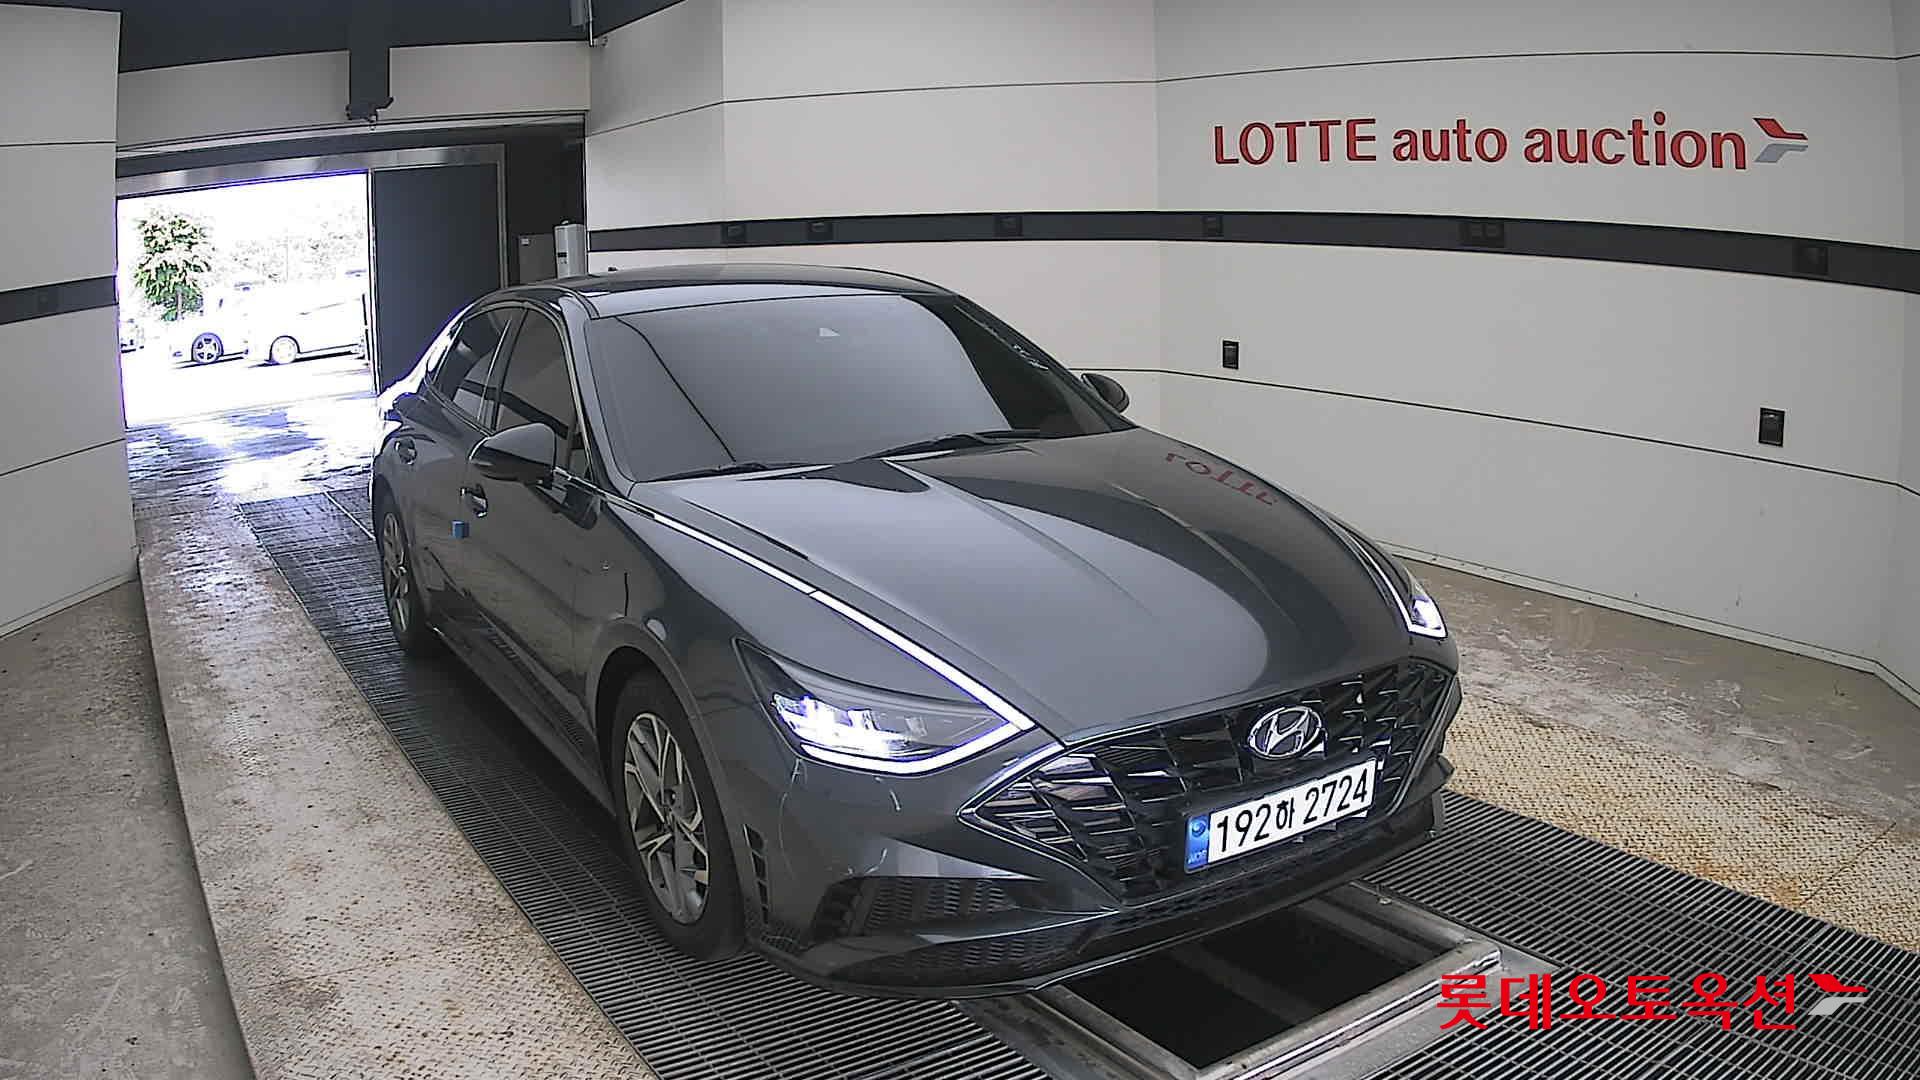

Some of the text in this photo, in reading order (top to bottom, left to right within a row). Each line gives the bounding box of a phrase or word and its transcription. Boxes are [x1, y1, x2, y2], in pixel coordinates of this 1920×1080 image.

[1214, 111, 1747, 169] LOTTE auto auction
[1217, 768, 1368, 853] 192하 2724
